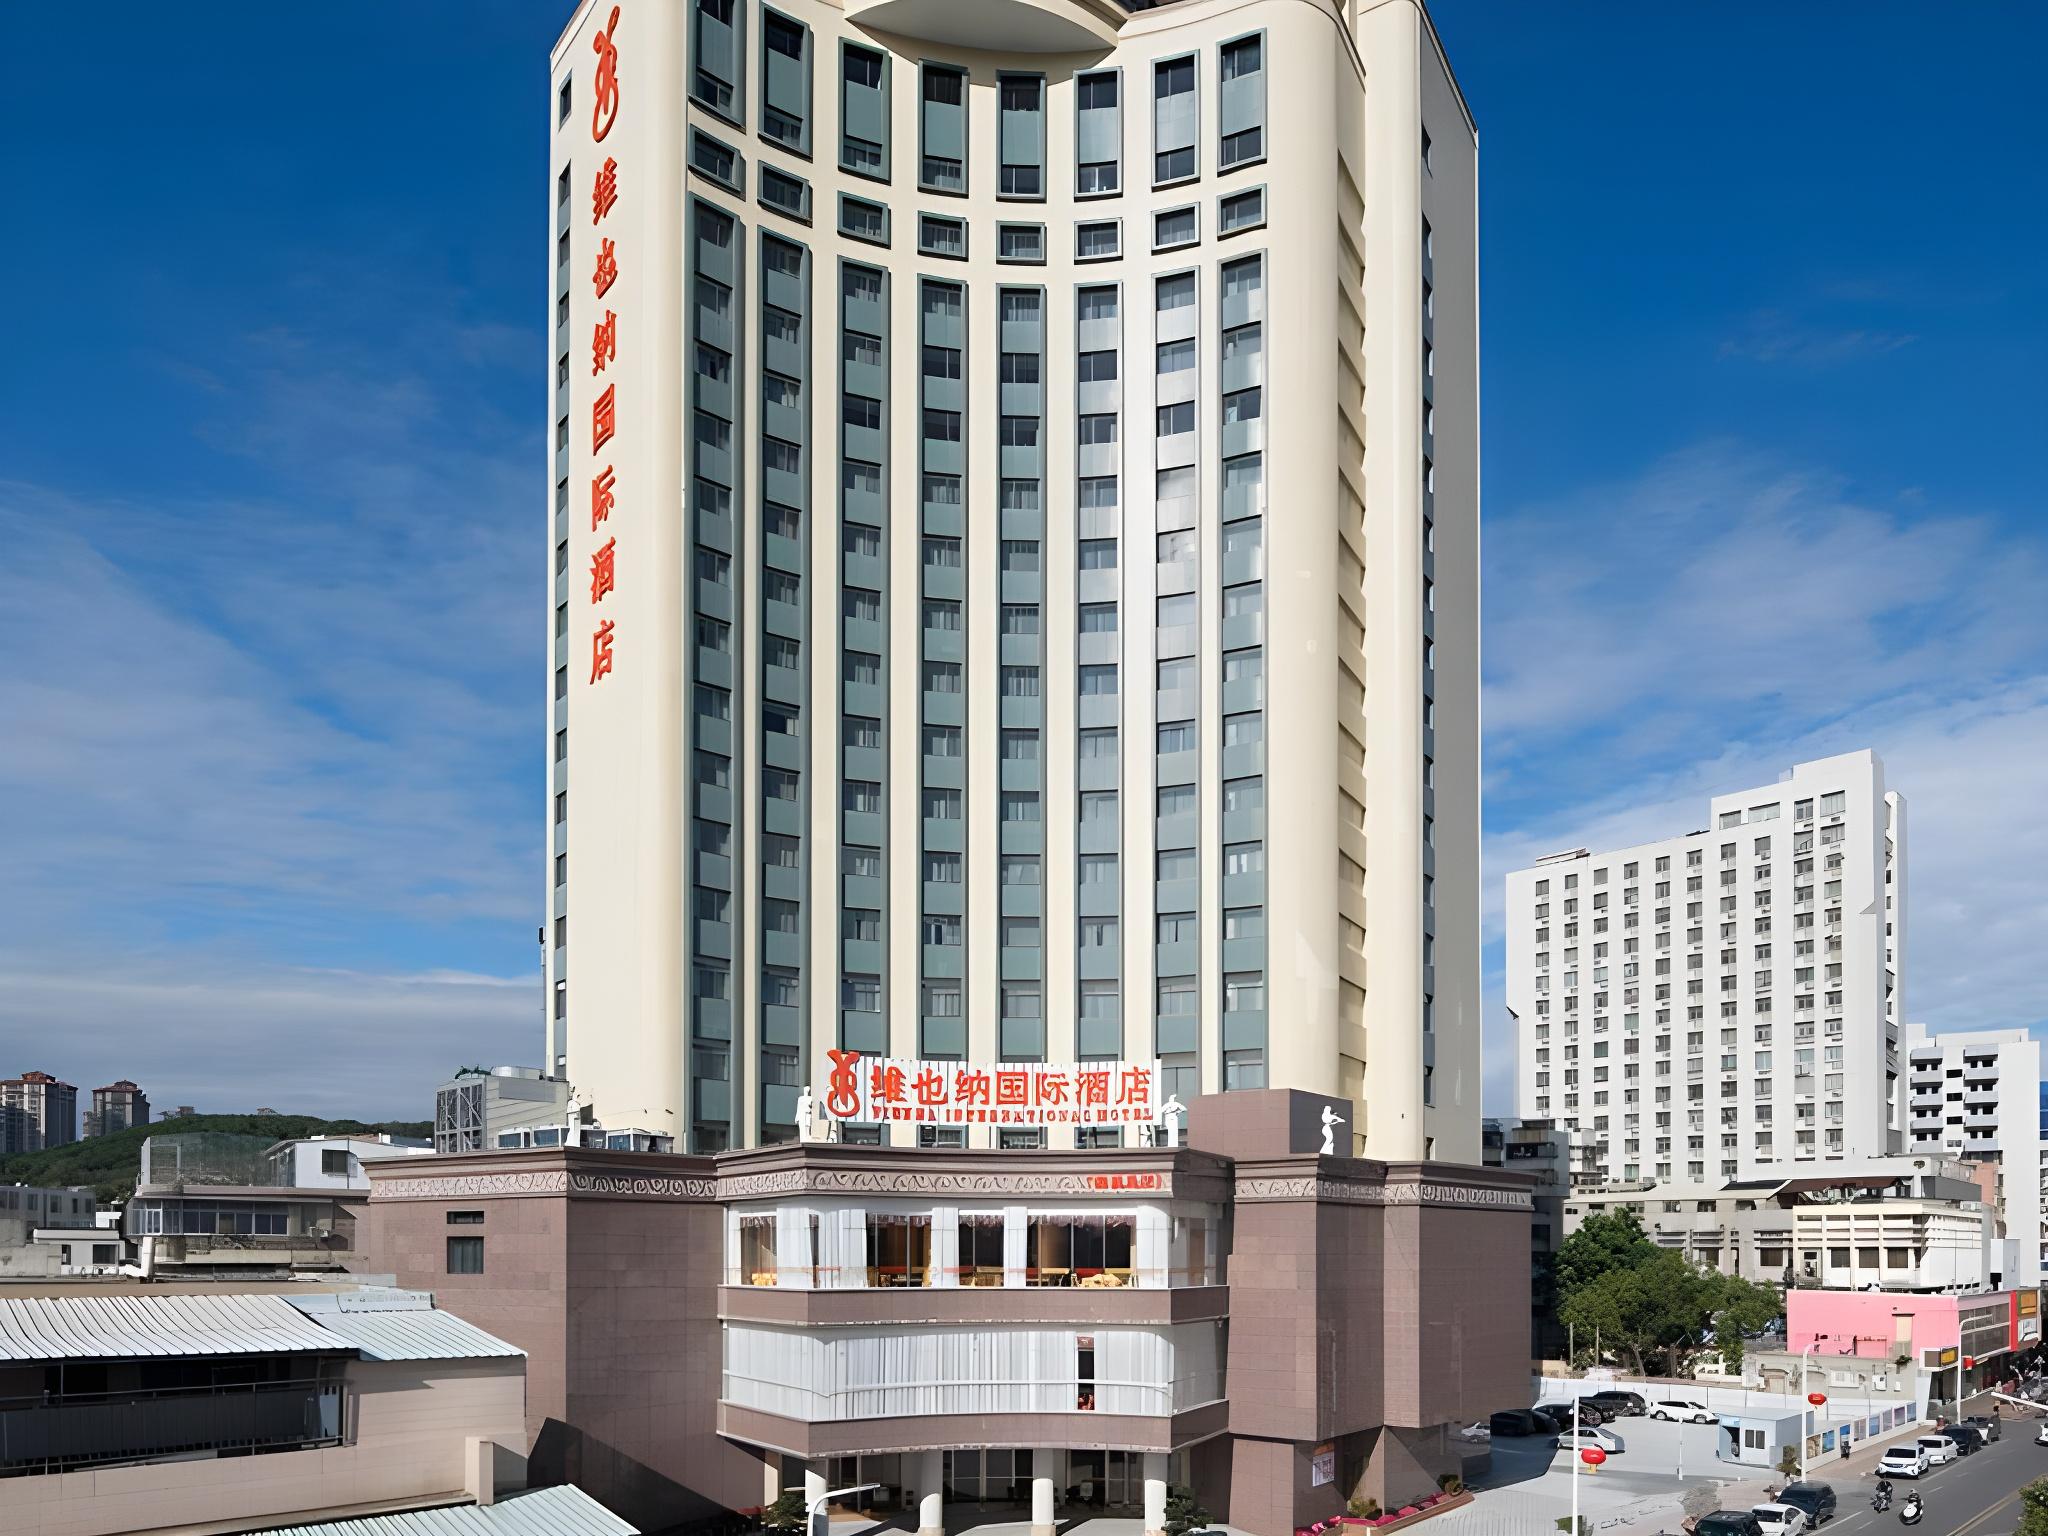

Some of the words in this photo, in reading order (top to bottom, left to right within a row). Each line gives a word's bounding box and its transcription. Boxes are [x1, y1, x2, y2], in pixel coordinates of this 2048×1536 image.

[590, 156, 618, 682] 维也纳国际酒店
[870, 1065, 1151, 1107] 维也纳国际酒店
